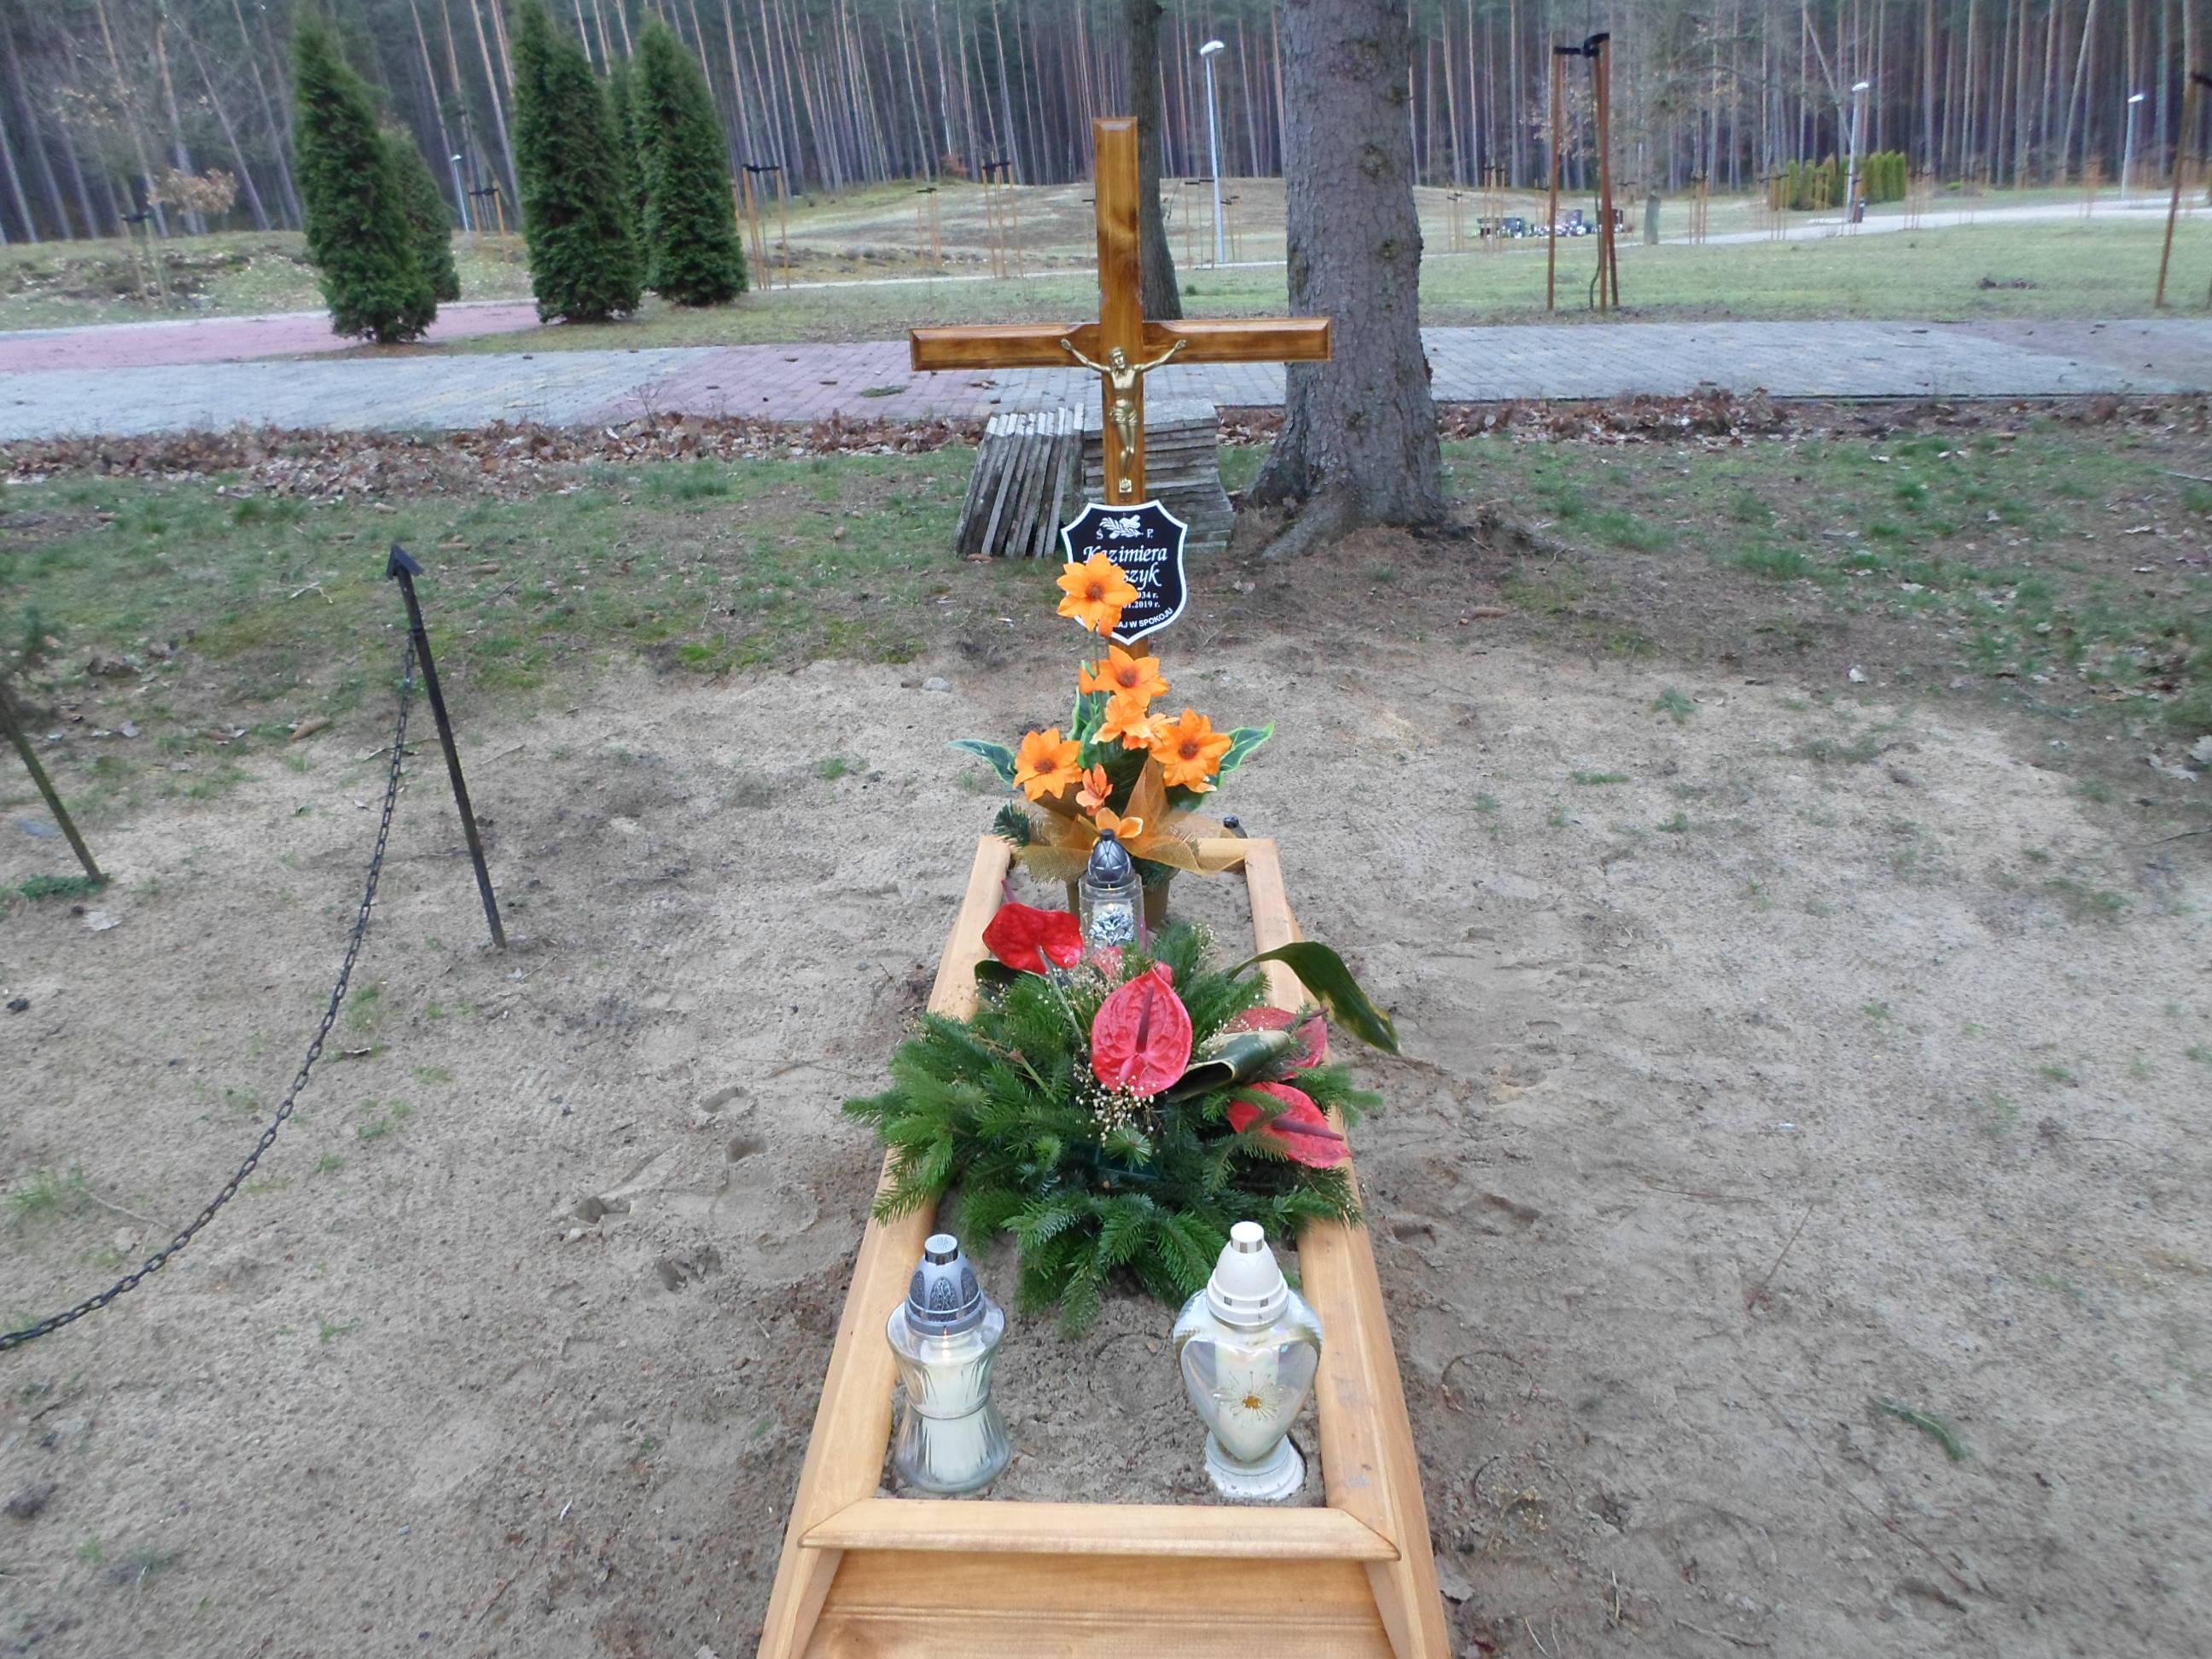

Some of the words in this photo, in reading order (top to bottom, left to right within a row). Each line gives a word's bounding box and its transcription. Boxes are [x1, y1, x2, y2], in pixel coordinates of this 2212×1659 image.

[1115, 620, 1128, 629] AJ
[1129, 620, 1138, 628] W
[1138, 607, 1173, 627] SPOKOJU
